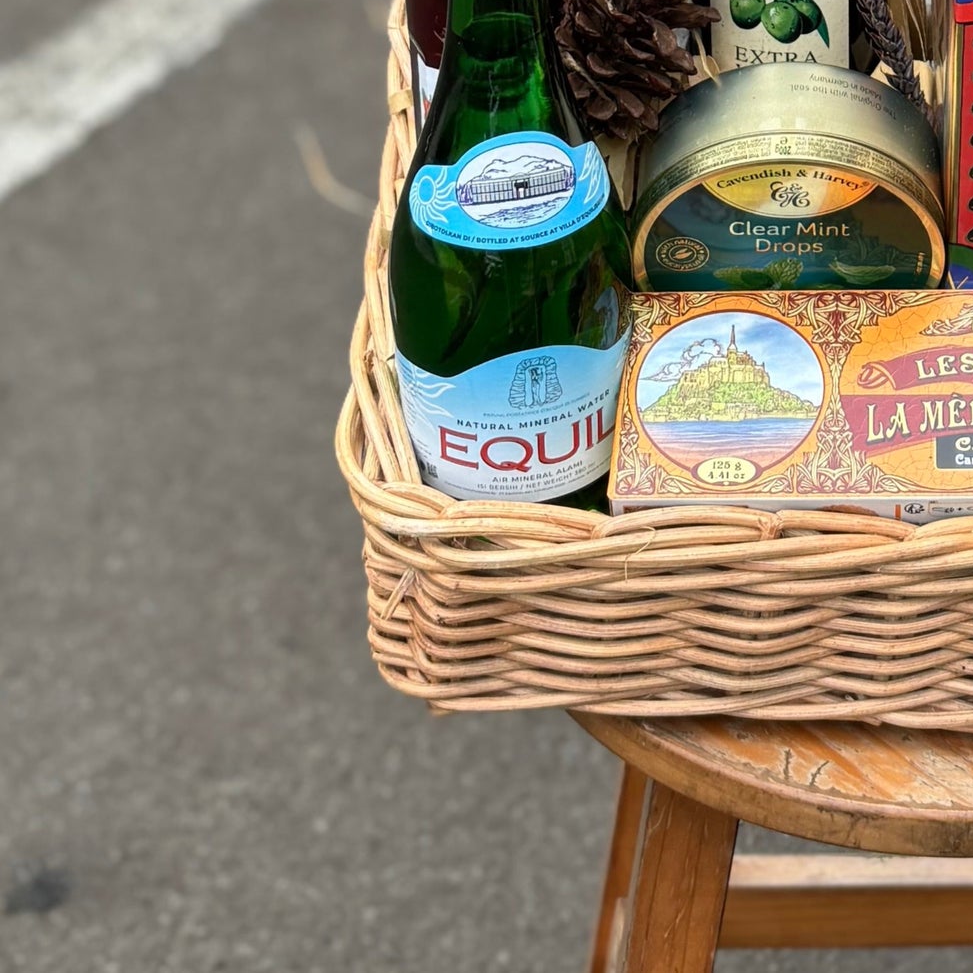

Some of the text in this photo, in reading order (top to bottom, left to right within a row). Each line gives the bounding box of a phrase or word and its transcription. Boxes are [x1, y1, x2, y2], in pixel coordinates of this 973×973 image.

[735, 45, 818, 64] EXTRA
[715, 167, 792, 190] Cavendish
[796, 168, 808, 178] &
[520, 231, 549, 243] SOURCE
[550, 227, 559, 236] AT
[559, 219, 577, 233] VILLA
[729, 220, 850, 237] Clear Mint
[755, 238, 824, 256] Drops
[457, 418, 513, 430] NATURAL
[519, 412, 573, 429] MINERAL
[577, 389, 610, 412] WATER
[866, 402, 912, 443] LA
[437, 406, 617, 473] EQUIL
[511, 470, 553, 482] MINERAL
[556, 460, 583, 474] ALAMI
[712, 460, 742, 471] 125 g
[525, 480, 541, 489] NET
[543, 472, 573, 486] WEIGHT
